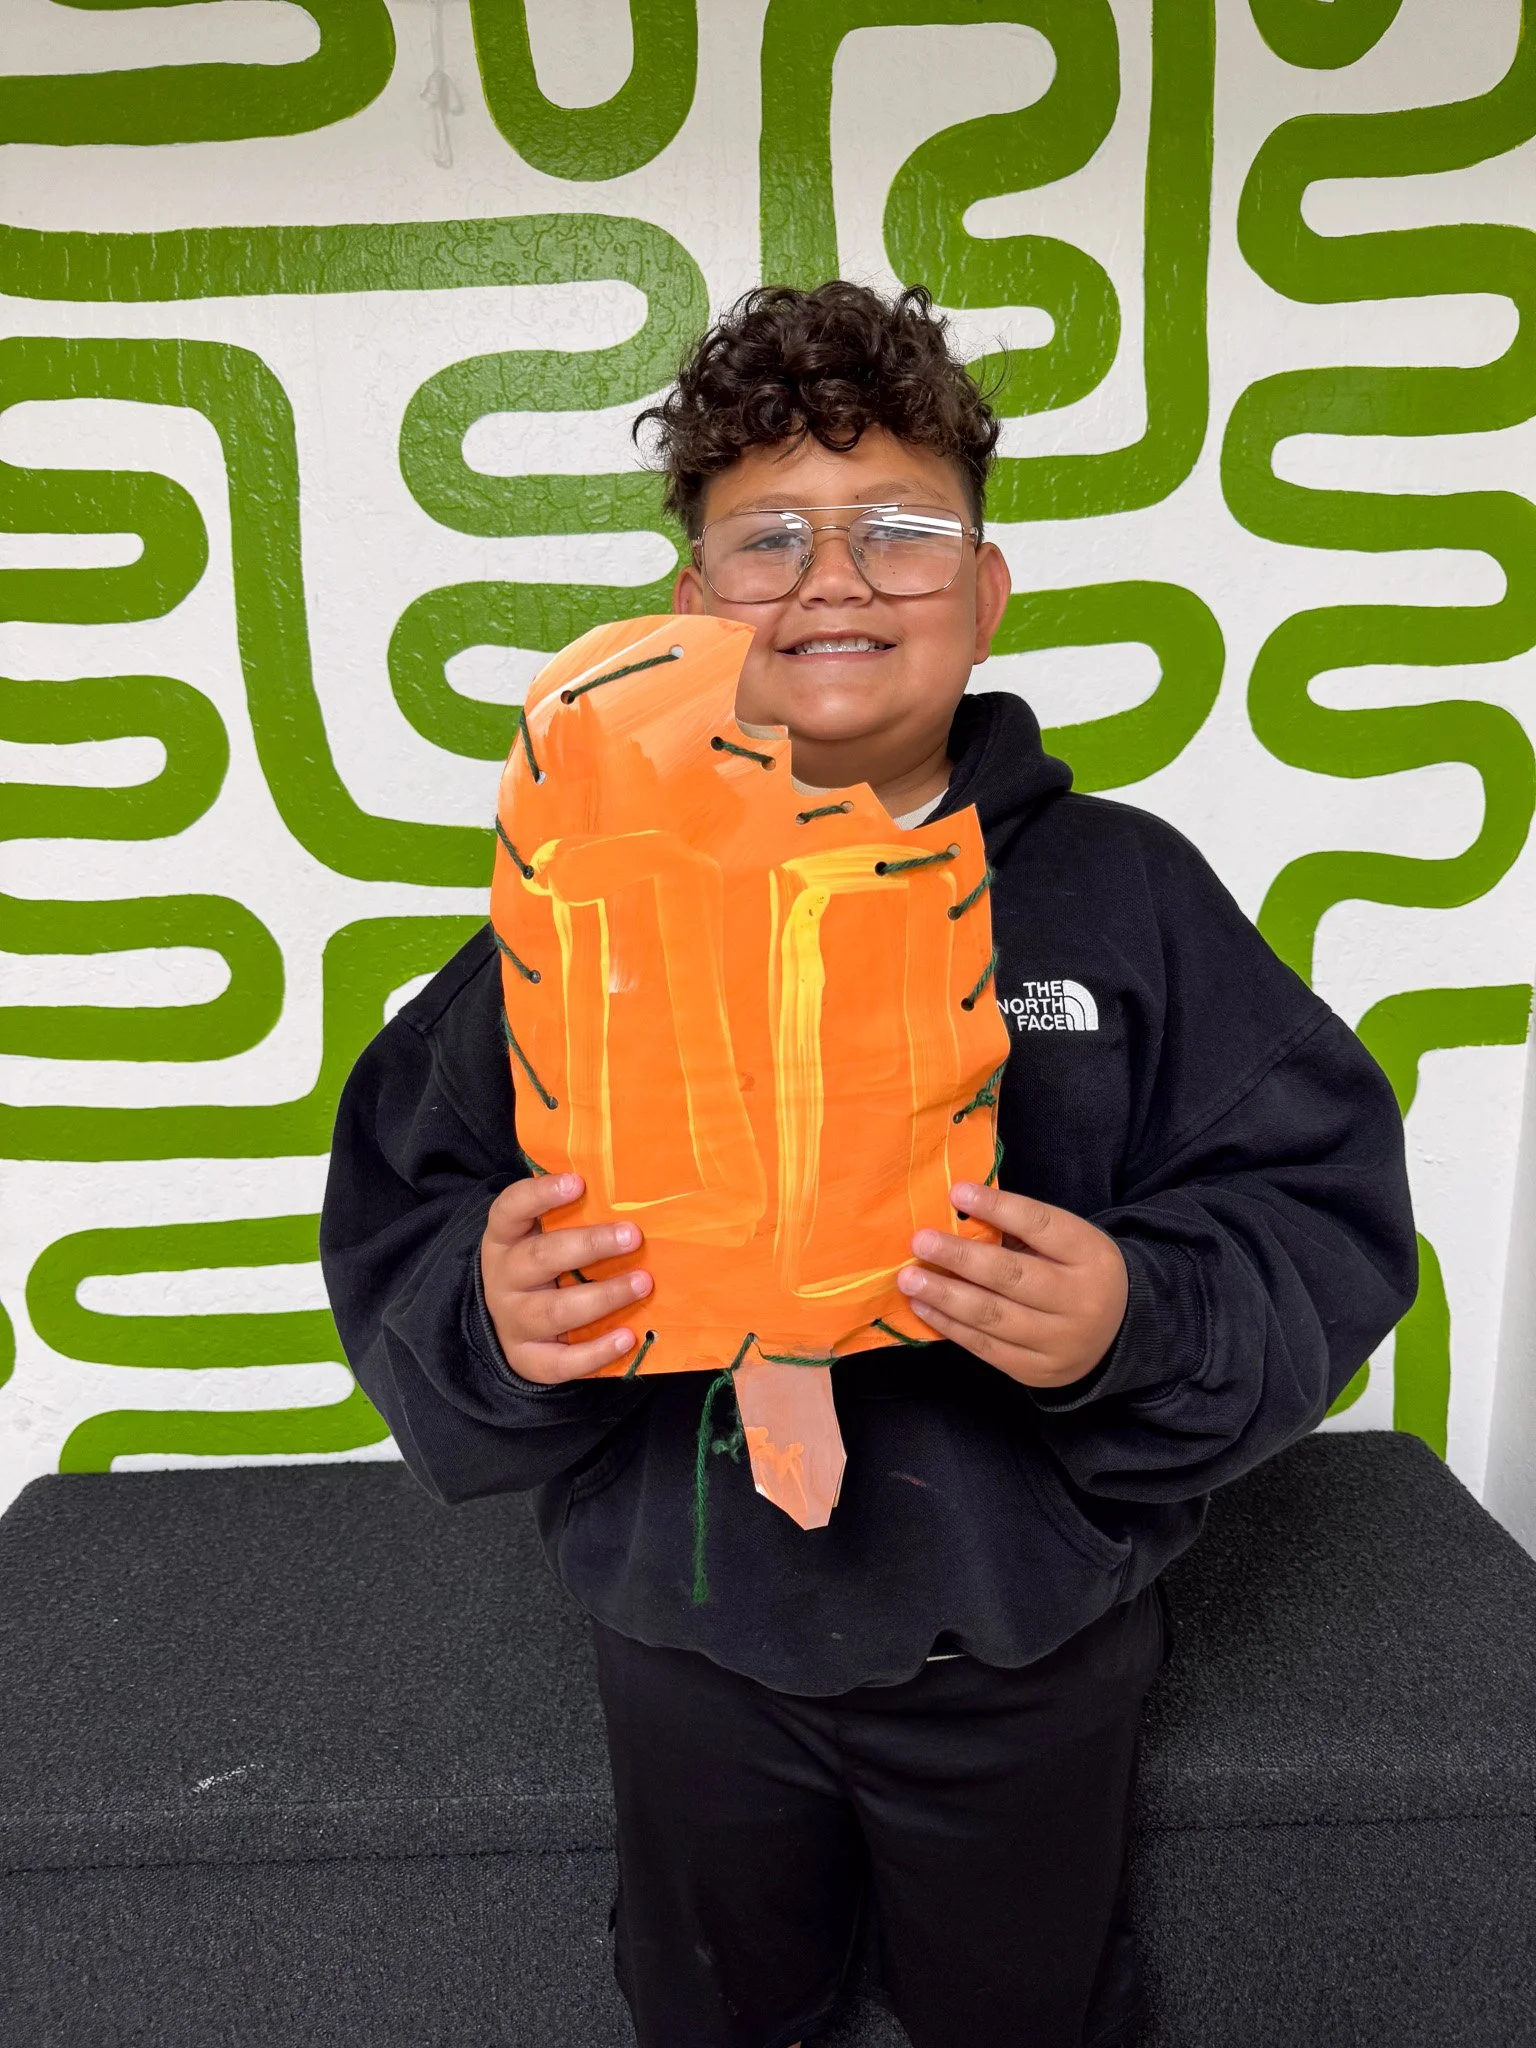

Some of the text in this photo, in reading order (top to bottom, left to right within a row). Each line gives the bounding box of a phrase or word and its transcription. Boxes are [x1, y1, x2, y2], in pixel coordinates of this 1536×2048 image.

[1023, 980, 1063, 997] THE
[997, 997, 1064, 1014] NORTH
[1016, 1014, 1066, 1031] FACE
